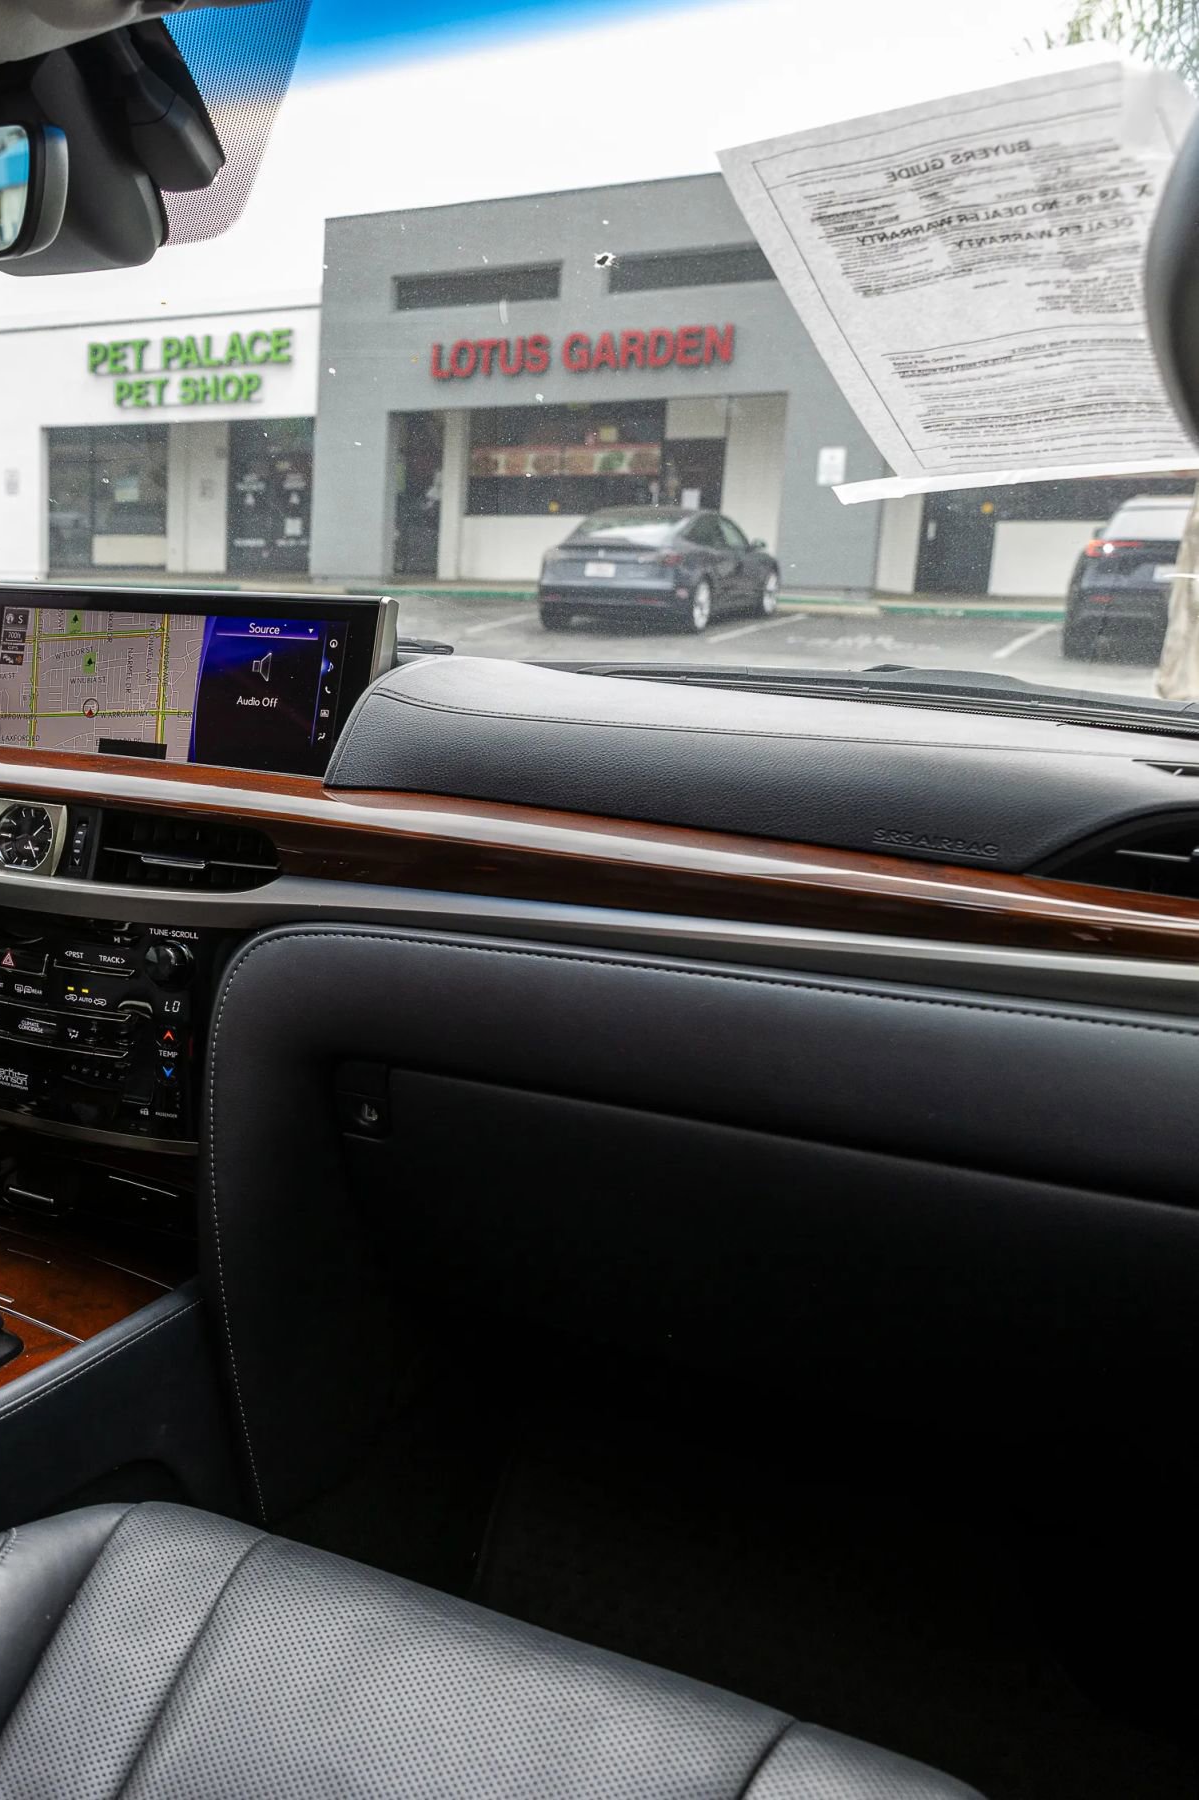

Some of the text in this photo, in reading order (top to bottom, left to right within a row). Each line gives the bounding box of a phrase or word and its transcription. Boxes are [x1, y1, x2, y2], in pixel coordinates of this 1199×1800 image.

[87, 328, 293, 374] PET PALACE
[430, 322, 736, 380] LOTUS GARDEN
[114, 372, 262, 407] PET SHOP
[249, 622, 281, 635] Source
[62, 648, 86, 659] TUDOR
[125, 683, 132, 694] DR
[236, 696, 278, 708] Audio Off
[873, 828, 1000, 857] SRS AIRBAG
[78, 996, 93, 1004] AUTO
[164, 1000, 181, 1013] LO
[158, 1049, 179, 1058] TEMP
